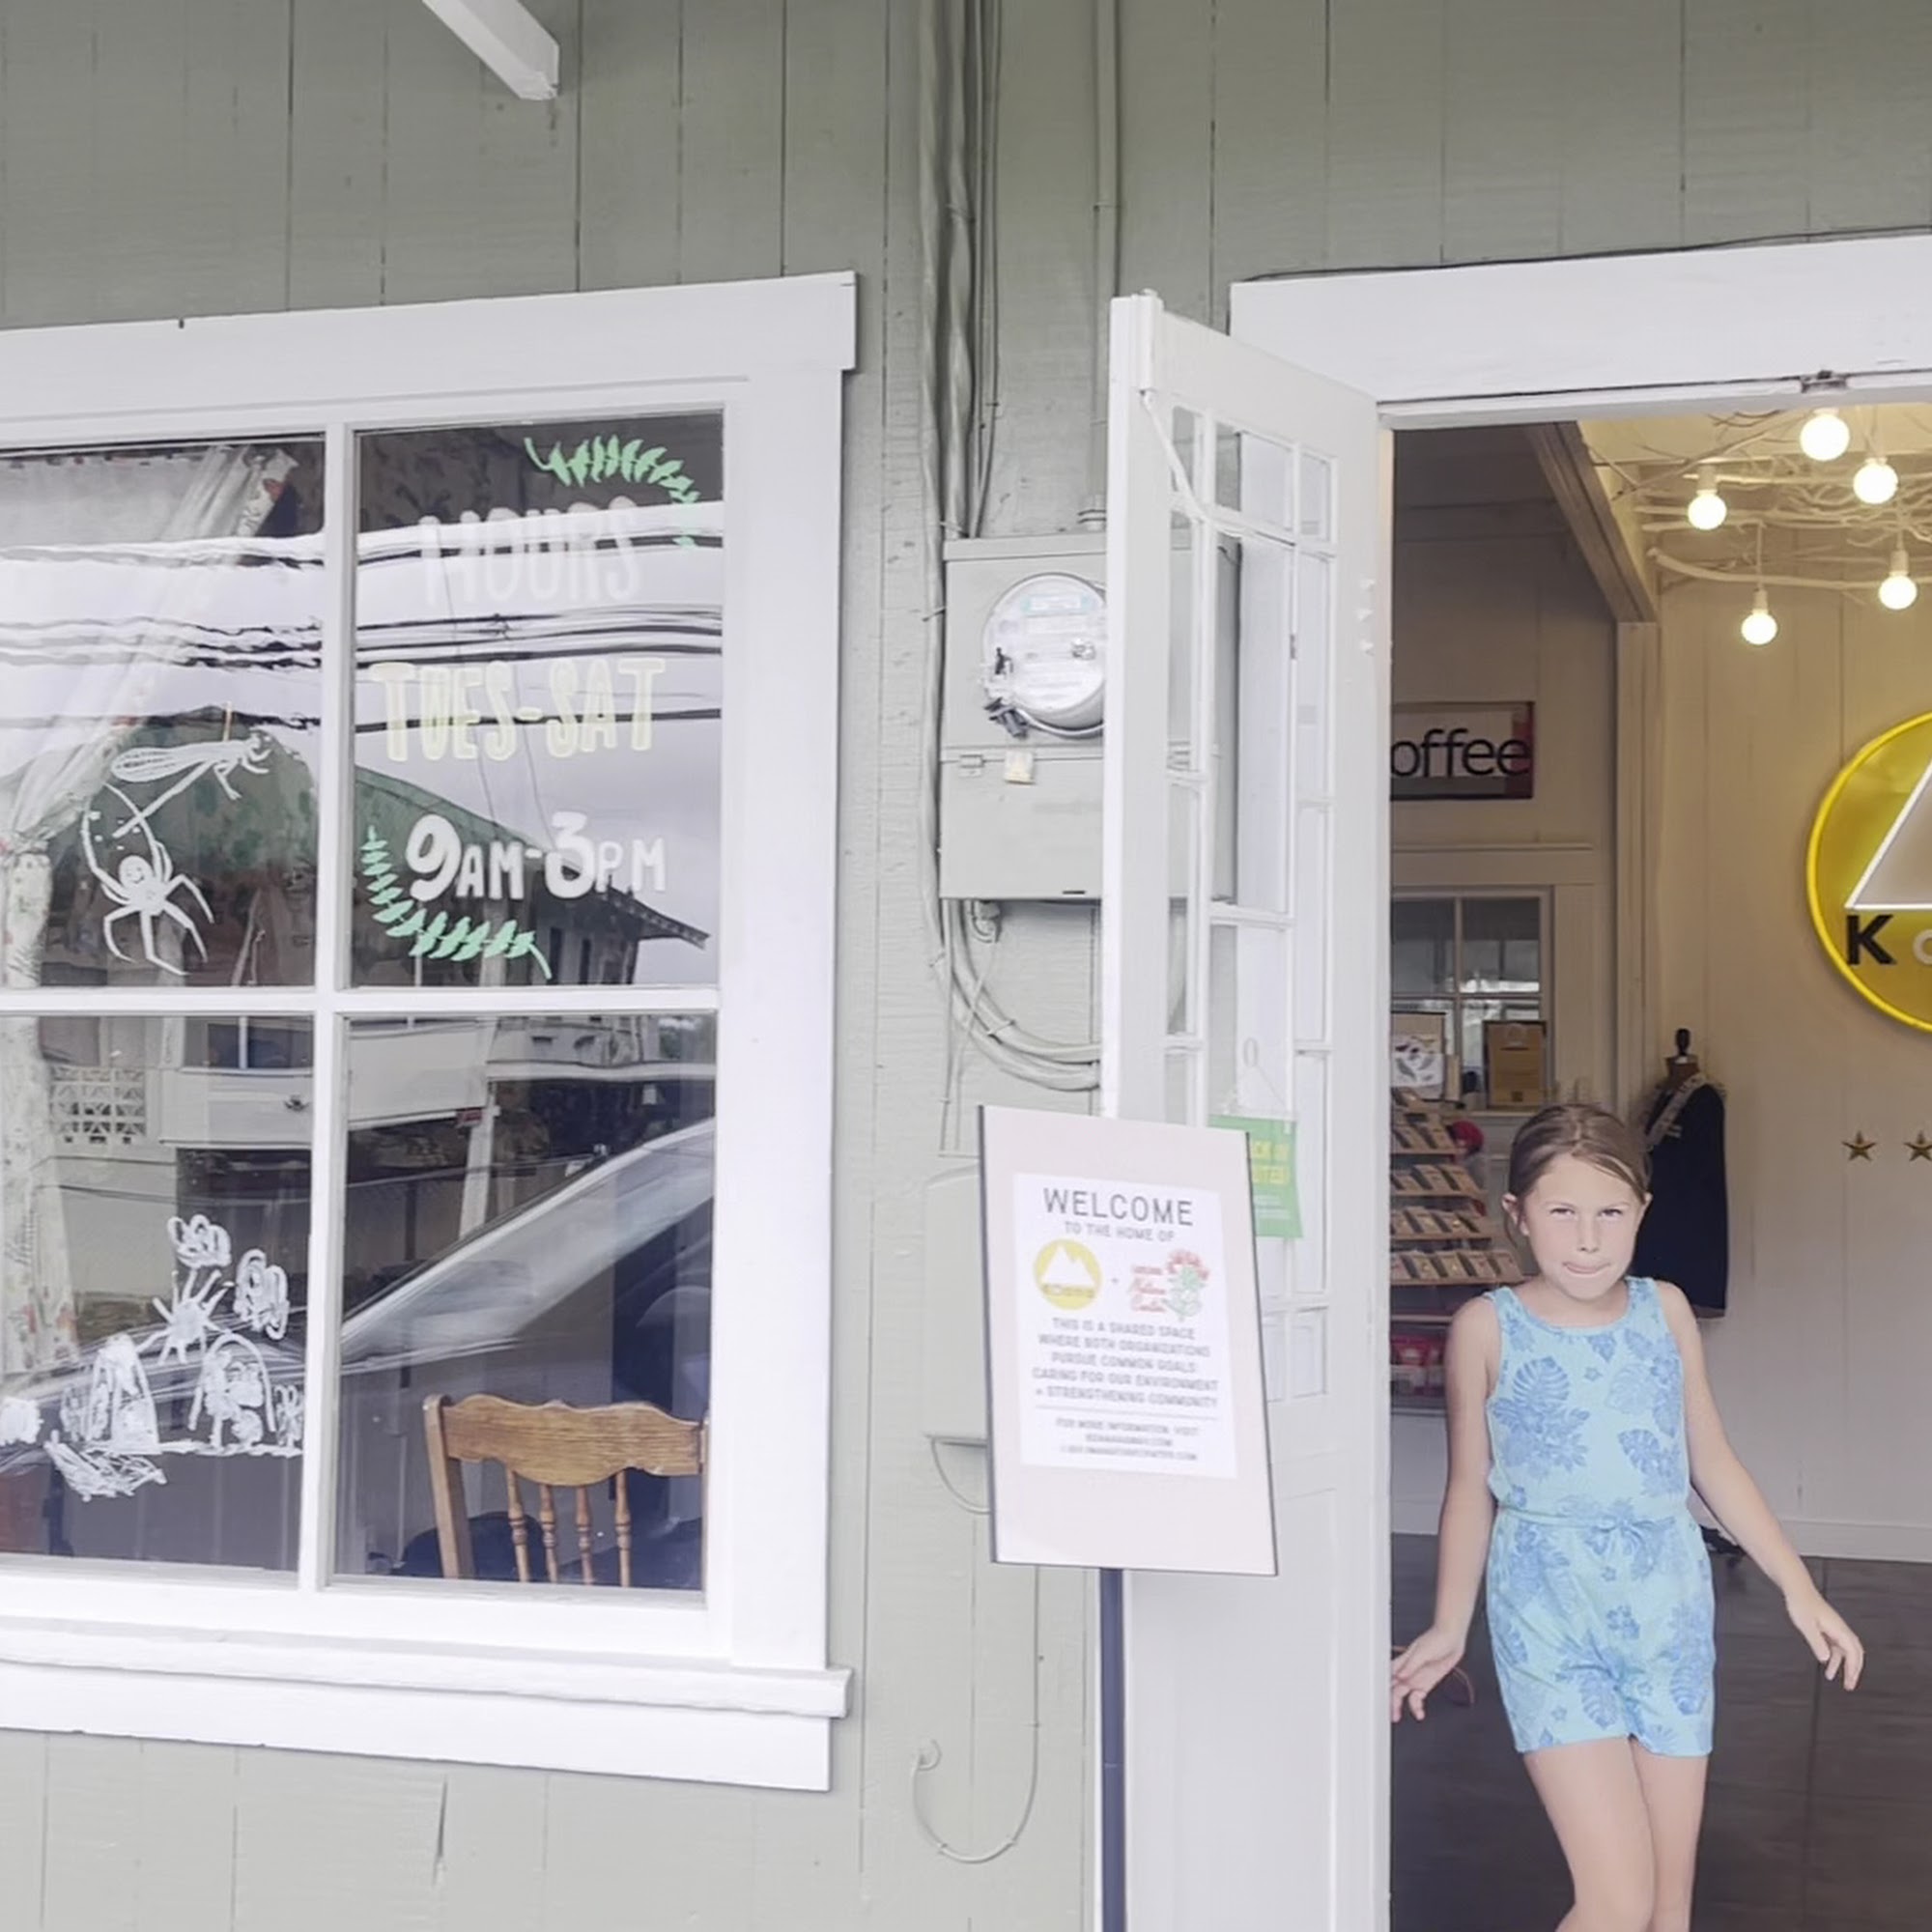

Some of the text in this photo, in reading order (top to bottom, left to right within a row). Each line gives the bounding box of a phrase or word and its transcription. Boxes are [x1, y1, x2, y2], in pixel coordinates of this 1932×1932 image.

[418, 495, 643, 606] HOURS
[368, 657, 667, 762] TUES-SAT
[1391, 727, 1532, 778] offee
[406, 811, 667, 903] 9AM-3PM
[1043, 1187, 1193, 1226] WELCOME
[1065, 1221, 1176, 1242] TO THE HOME OF
[1053, 1318, 1196, 1340] THIS IS A SHARED SPACE
[1037, 1333, 1210, 1358] WHERE BOTH ORGANIZATIONS
[1051, 1351, 1097, 1367] PURSUE
[1100, 1354, 1153, 1370] COMMON
[1032, 1367, 1219, 1392] CARING FOR OUR ENVIRONMENT
[1046, 1385, 1145, 1404] STRENGTHENING
[1149, 1393, 1218, 1407] COMMUNITY
